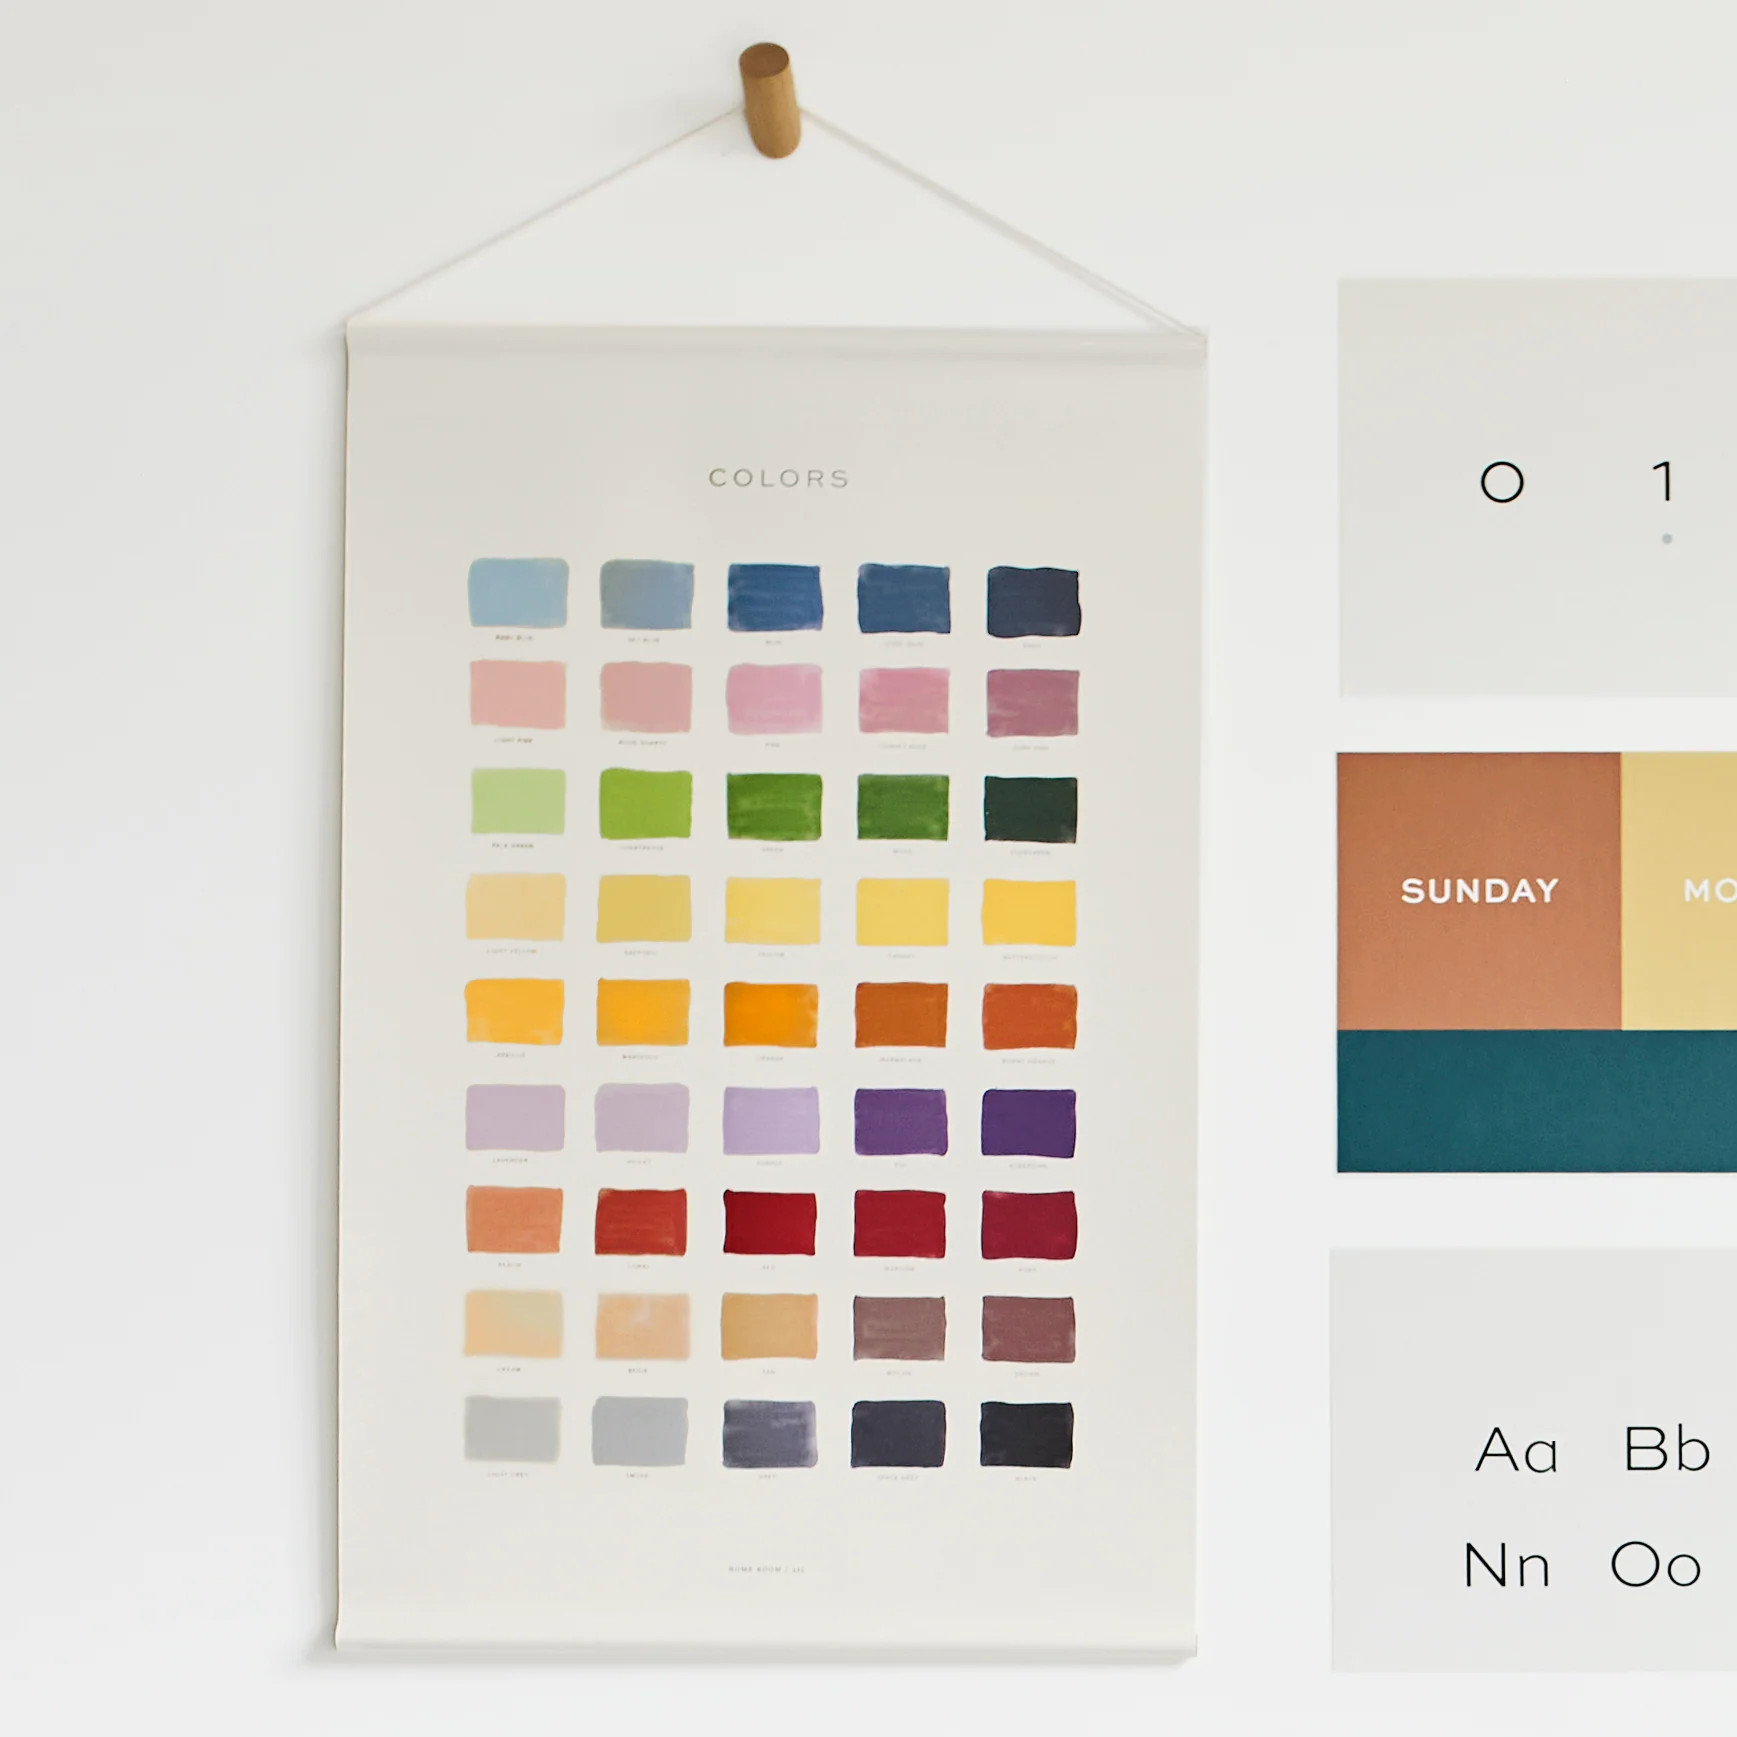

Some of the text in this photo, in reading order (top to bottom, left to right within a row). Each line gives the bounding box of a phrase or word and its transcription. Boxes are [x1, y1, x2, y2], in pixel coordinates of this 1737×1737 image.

[708, 467, 848, 489] COLORS
[1480, 460, 1525, 504] 0
[1652, 460, 1671, 502] 1
[1401, 878, 1559, 904] SUNDAY
[1474, 1426, 1557, 1474] Aa
[1626, 1422, 1710, 1472] Bb
[1466, 1542, 1549, 1588] Nn
[1611, 1540, 1701, 1588] Oo
